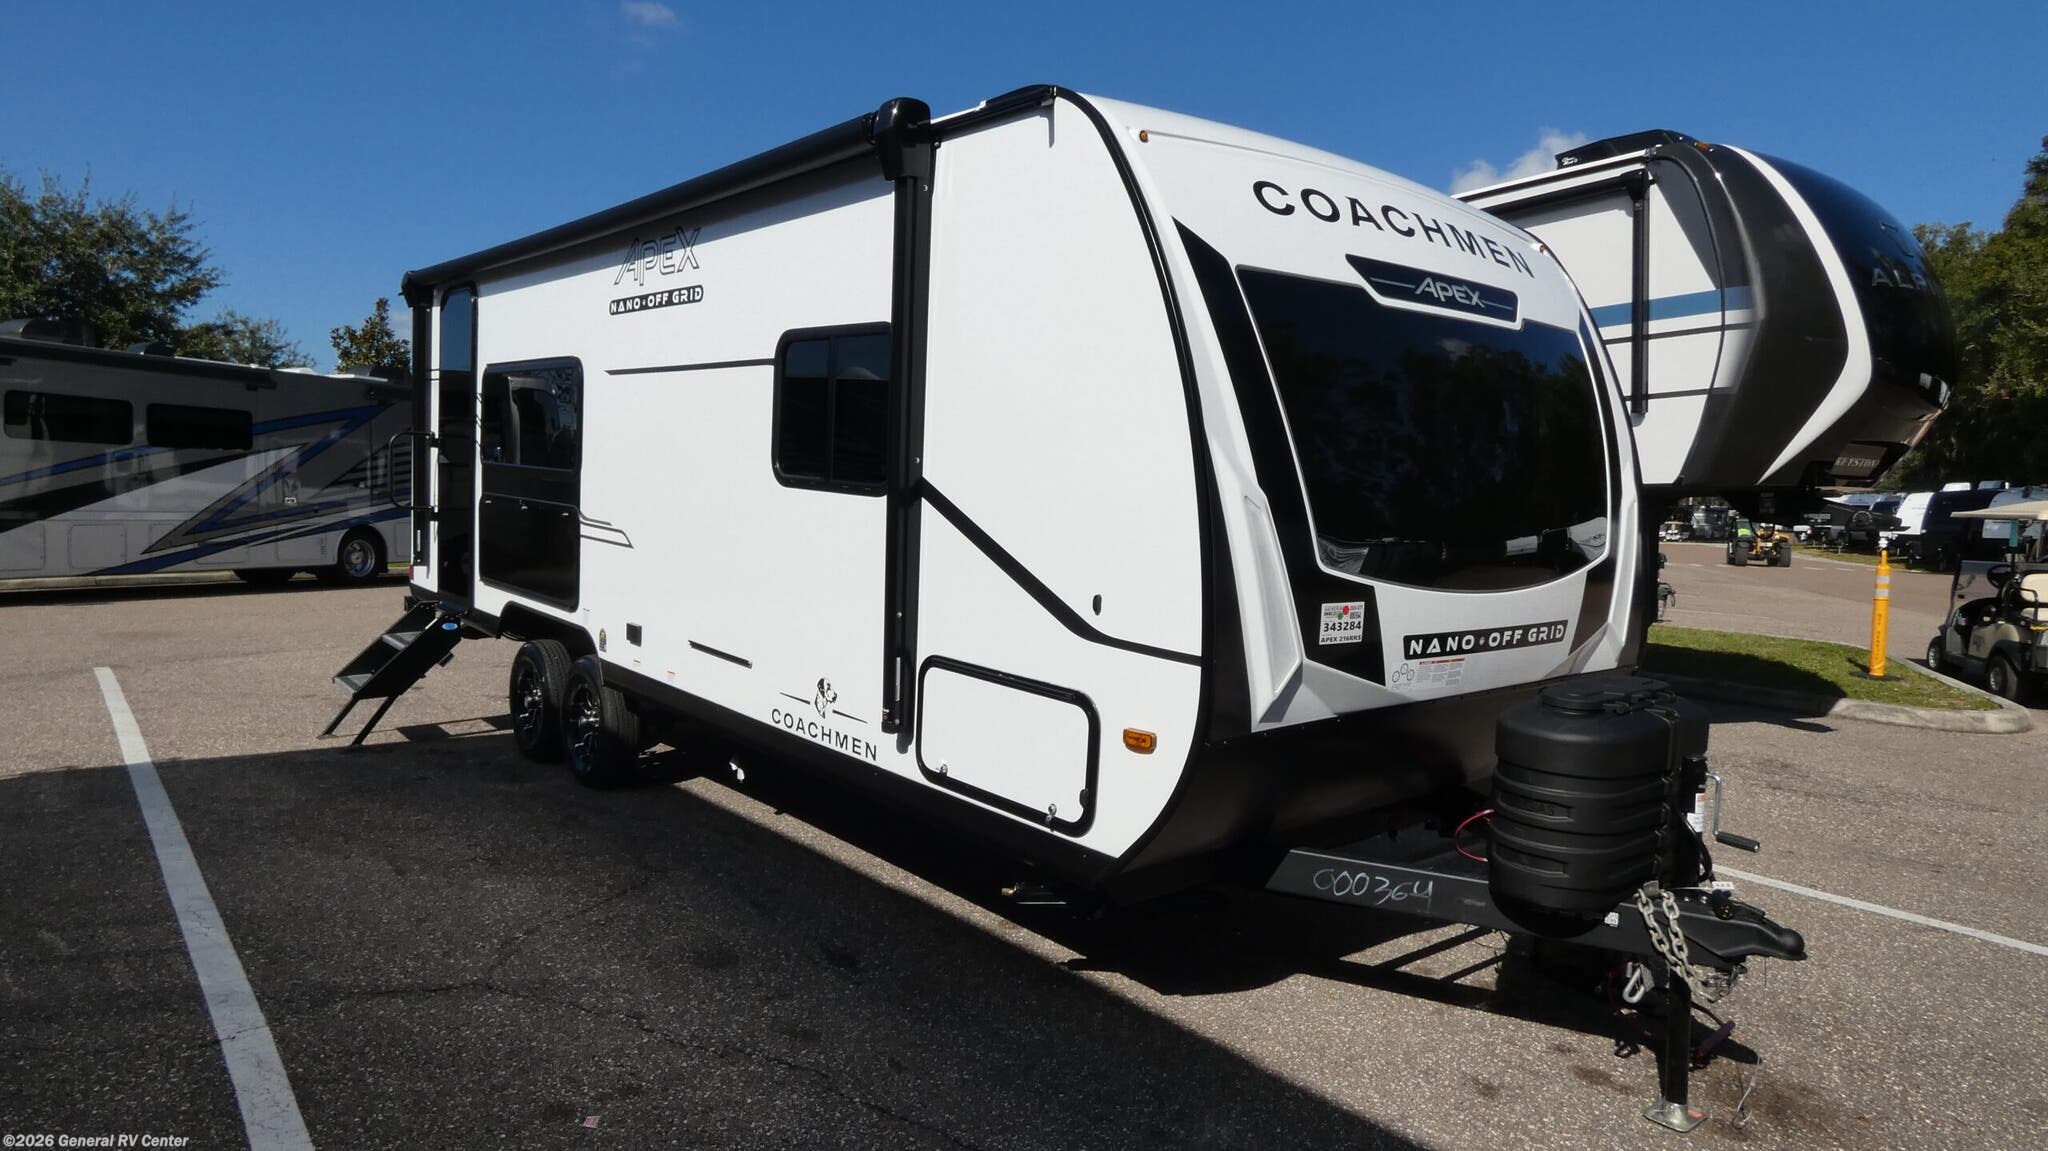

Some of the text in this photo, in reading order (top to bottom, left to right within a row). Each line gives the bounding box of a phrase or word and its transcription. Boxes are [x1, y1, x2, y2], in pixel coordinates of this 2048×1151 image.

[1252, 180, 1535, 279] COACHMEN
[614, 227, 702, 285] APEX
[611, 288, 702, 313] NANO OFF GRID
[1413, 276, 1486, 309] APEX
[1323, 620, 1362, 632] 343284
[1408, 624, 1565, 656] NANO OFF GRID
[771, 708, 877, 762] COACHMEN
[1312, 868, 1434, 914] 000364
